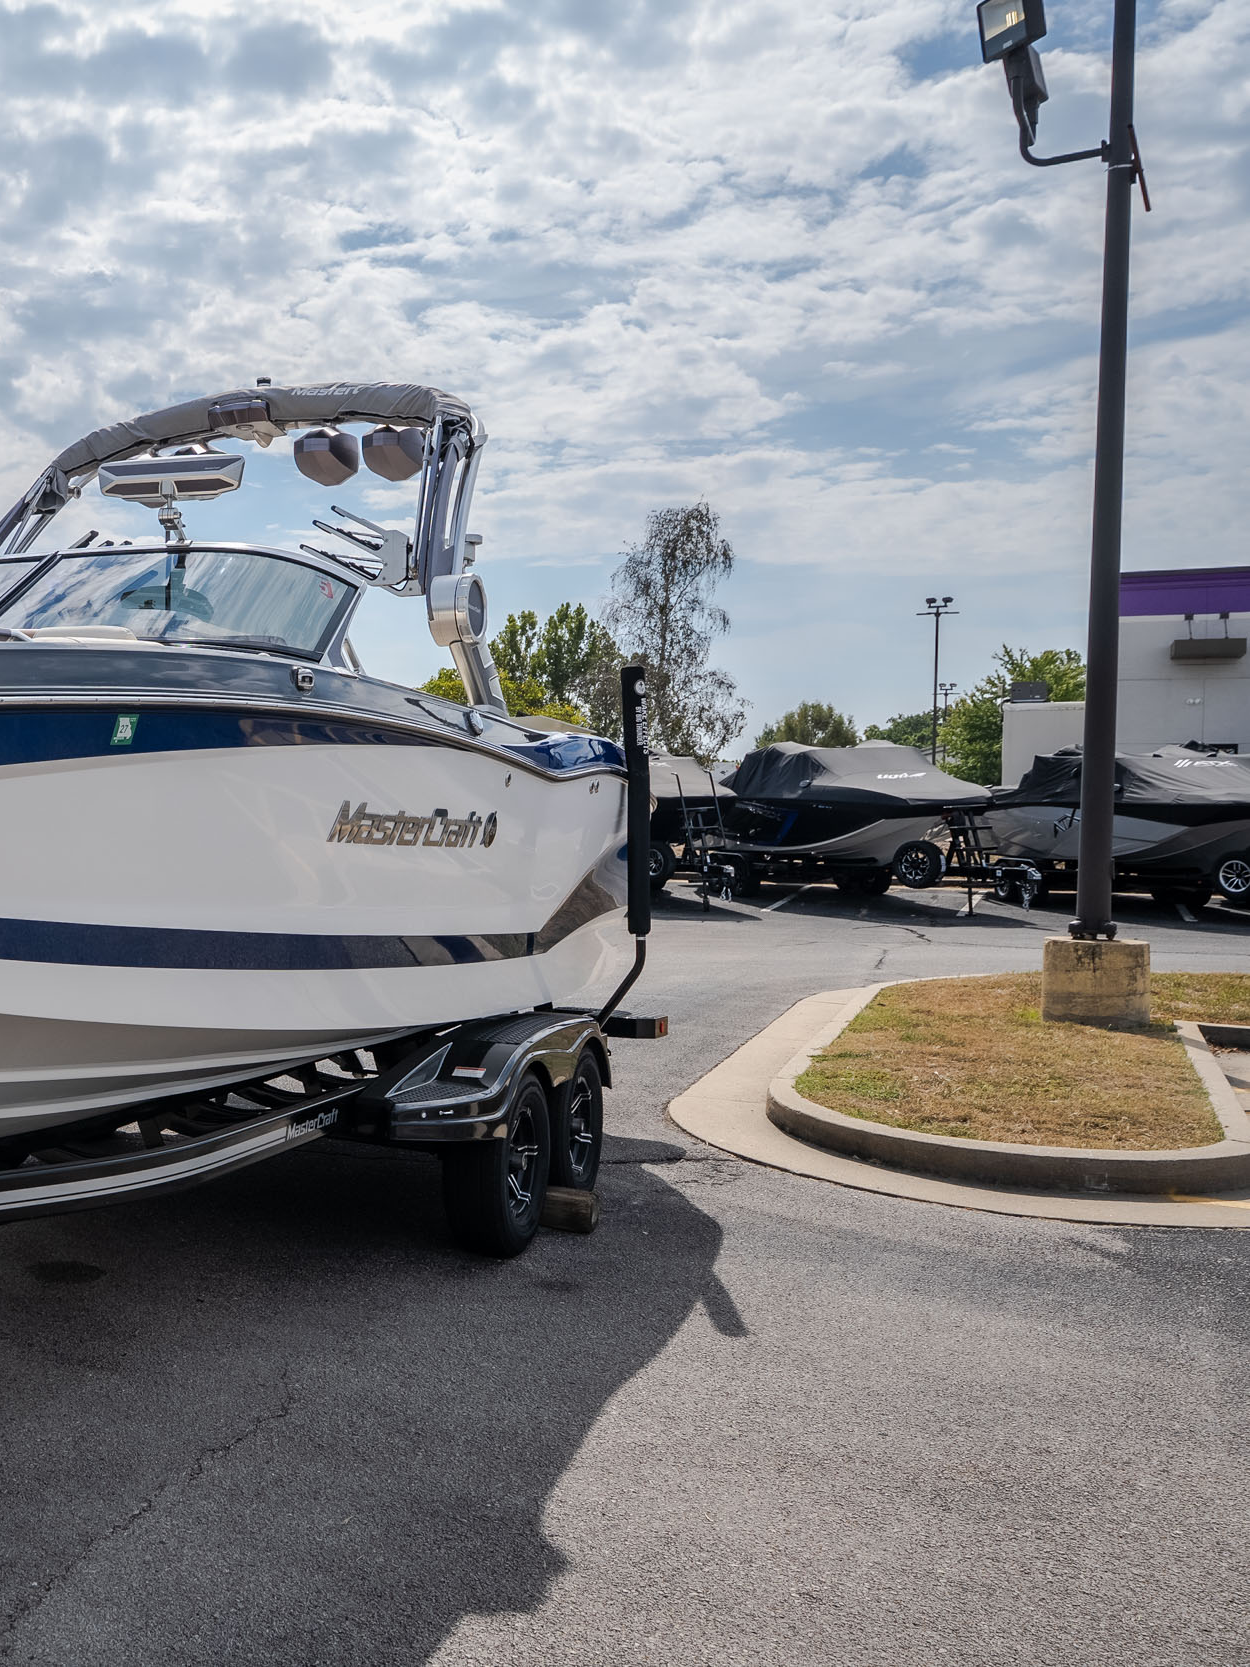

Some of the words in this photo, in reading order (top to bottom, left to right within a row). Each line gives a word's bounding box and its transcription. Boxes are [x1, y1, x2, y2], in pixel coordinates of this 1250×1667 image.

[119, 724, 129, 734] 27
[326, 800, 482, 848] MasterCraft
[286, 1107, 339, 1141] MasterCraft
